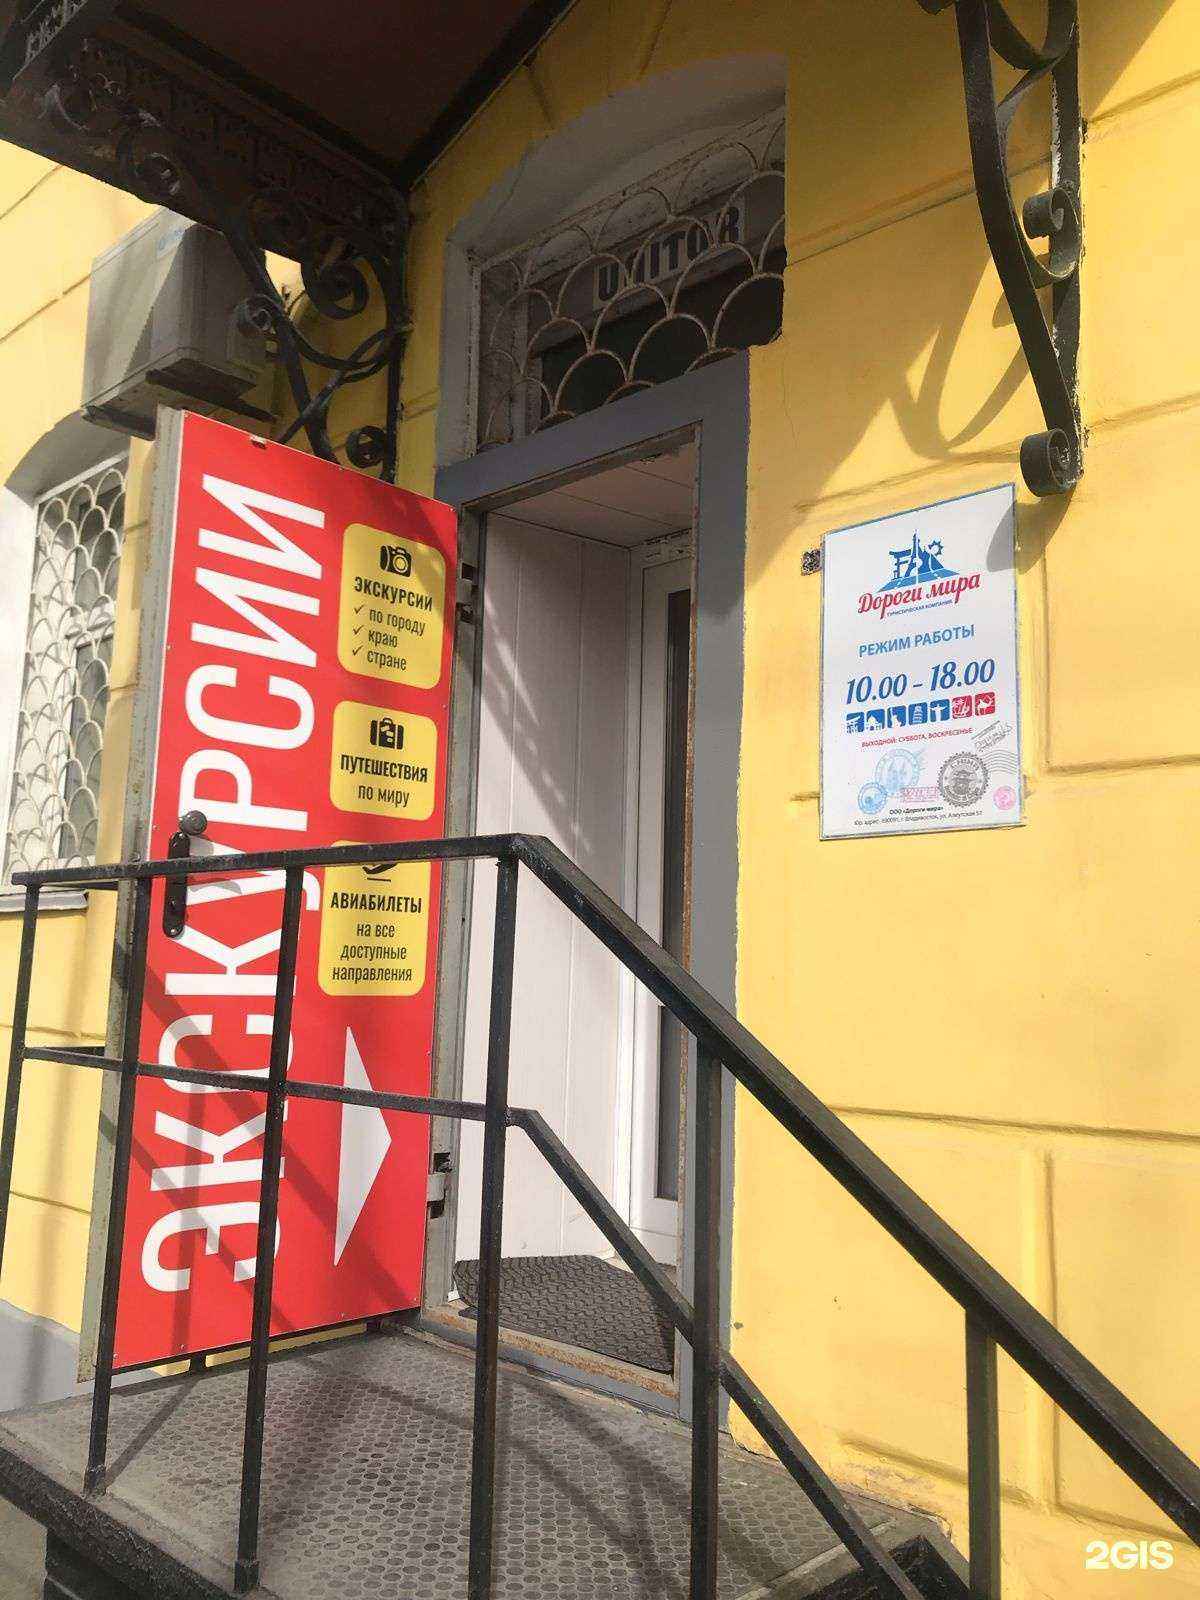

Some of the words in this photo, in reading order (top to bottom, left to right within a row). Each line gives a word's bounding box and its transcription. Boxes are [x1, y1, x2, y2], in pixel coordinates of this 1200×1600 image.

[354, 576, 433, 611] ЭКСКУРСИИ
[858, 588, 922, 619] Дороги
[925, 574, 981, 604] мира
[369, 609, 383, 623] по
[387, 613, 426, 637] городу
[368, 630, 398, 648] краю
[859, 636, 911, 658] РЕЖИМ
[914, 624, 975, 647] РАБОТЫ
[367, 650, 407, 671] стране
[846, 673, 907, 705] 10.00
[930, 659, 995, 692] 18.00
[340, 755, 428, 783] ПУТЕШЕСТВИЯ
[358, 785, 373, 800] по
[378, 788, 410, 807] миру
[141, 474, 325, 1293] ЭКСКУРСИИ
[330, 892, 422, 913] АВИАБИЛЕТЫ
[356, 923, 371, 937] на
[375, 925, 395, 937] все
[340, 944, 407, 961] доступные
[332, 967, 412, 984] направления
